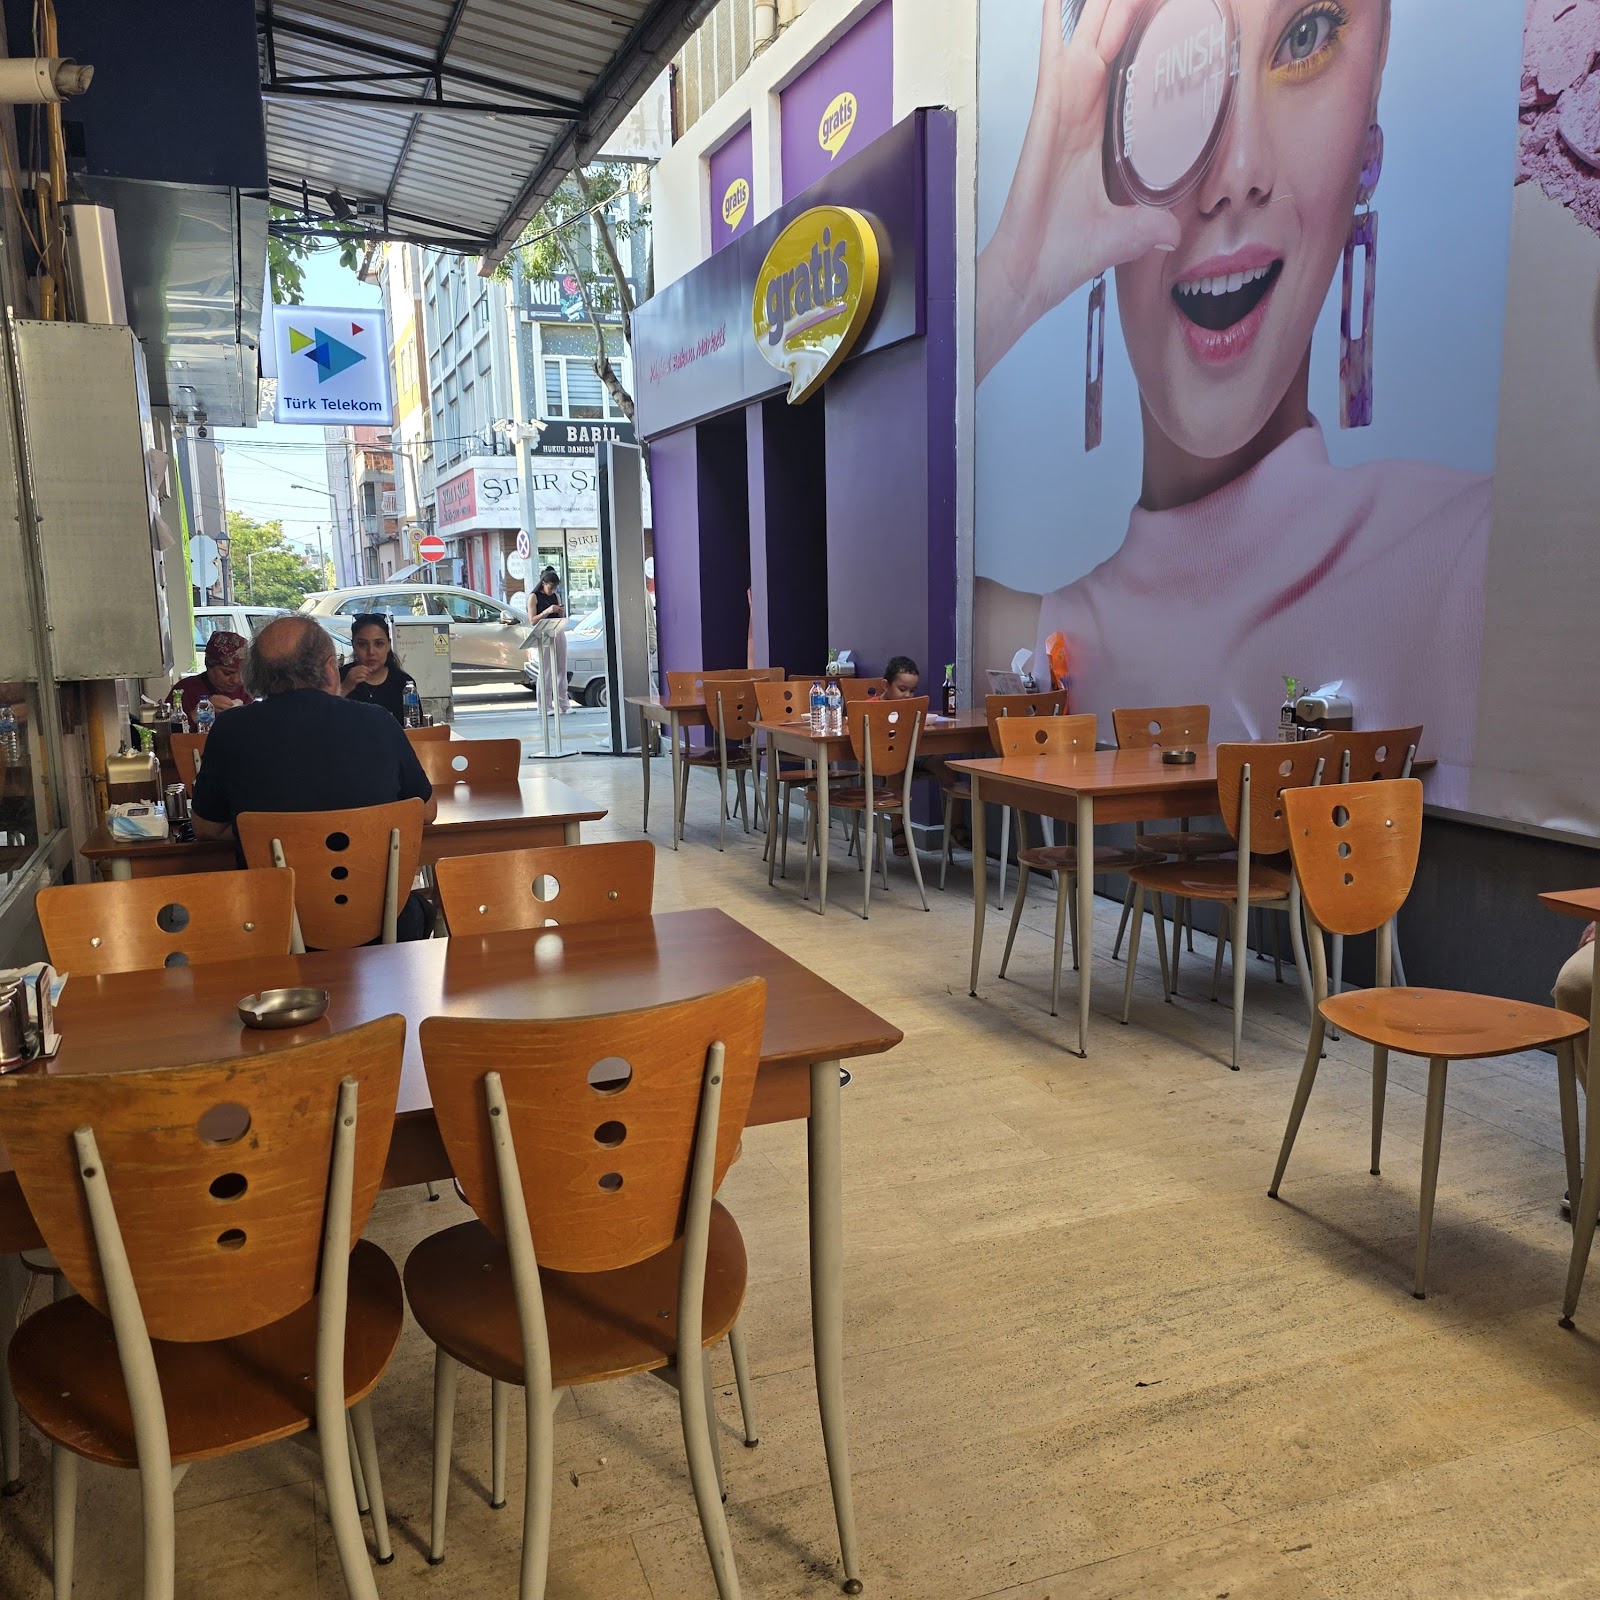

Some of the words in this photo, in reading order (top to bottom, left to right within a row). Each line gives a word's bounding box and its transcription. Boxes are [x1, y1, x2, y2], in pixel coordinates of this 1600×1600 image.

[1154, 17, 1226, 92] FINISH
[822, 96, 853, 145] gratis
[724, 182, 747, 219] gratis
[766, 224, 849, 346] gratis
[284, 397, 317, 410] Türk
[321, 398, 382, 412] Telekom
[542, 445, 566, 454] HUKUK
[567, 445, 595, 454] DANIŞM
[566, 424, 620, 442] BABİL
[483, 473, 562, 503] ŞIIR
